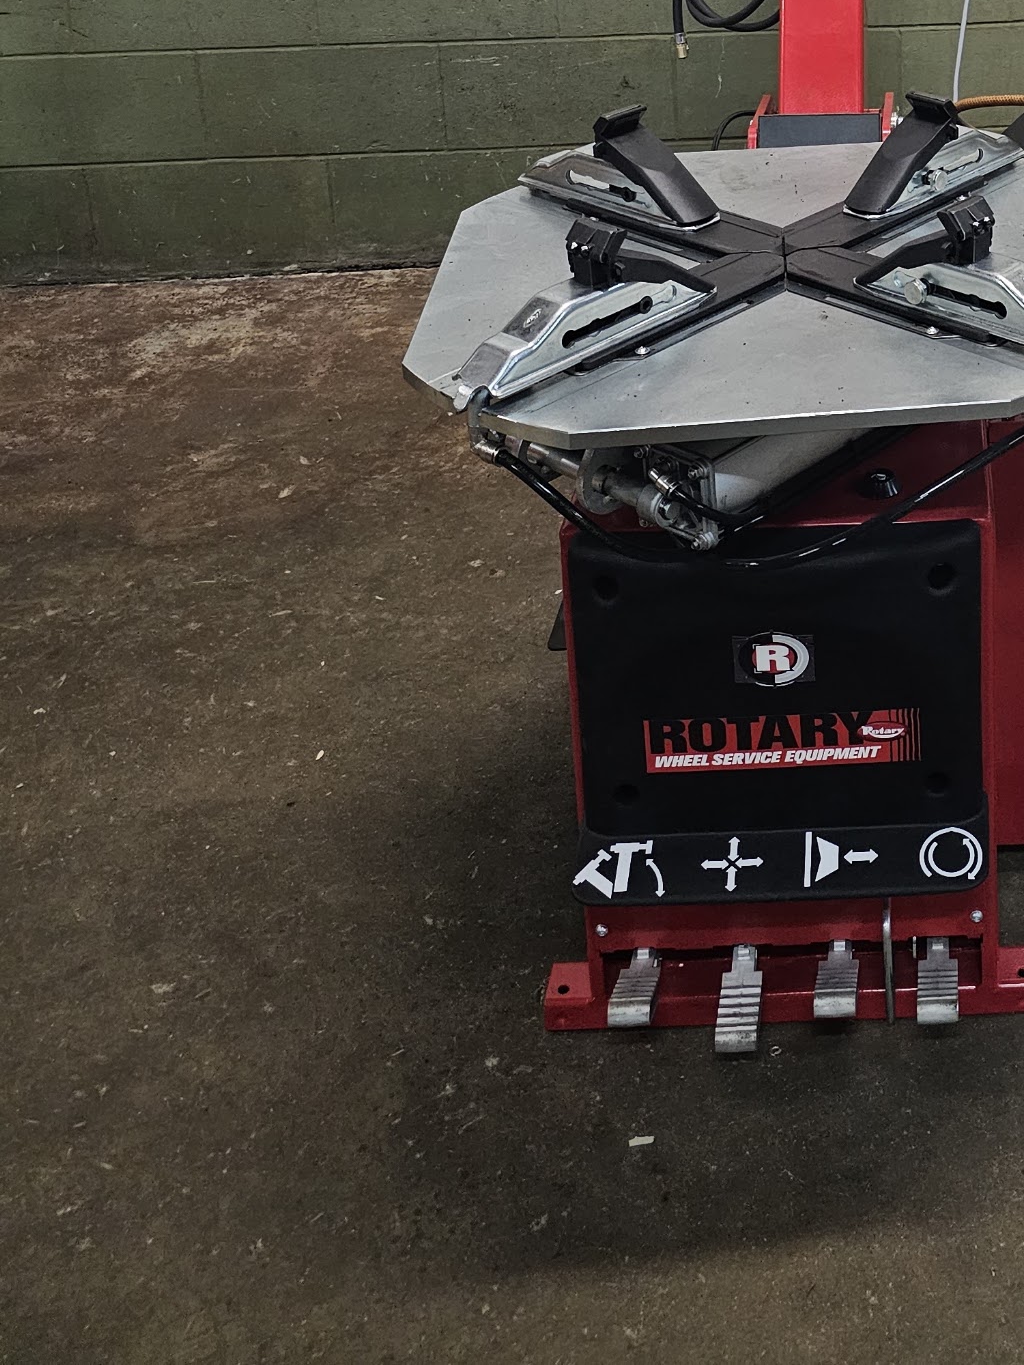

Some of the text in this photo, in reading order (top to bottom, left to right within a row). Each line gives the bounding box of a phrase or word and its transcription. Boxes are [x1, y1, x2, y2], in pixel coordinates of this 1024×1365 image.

[648, 711, 873, 754] ROTARY
[861, 725, 905, 739] Rotary
[655, 745, 882, 768] WHEEL SERVICE EQUIPMENT
